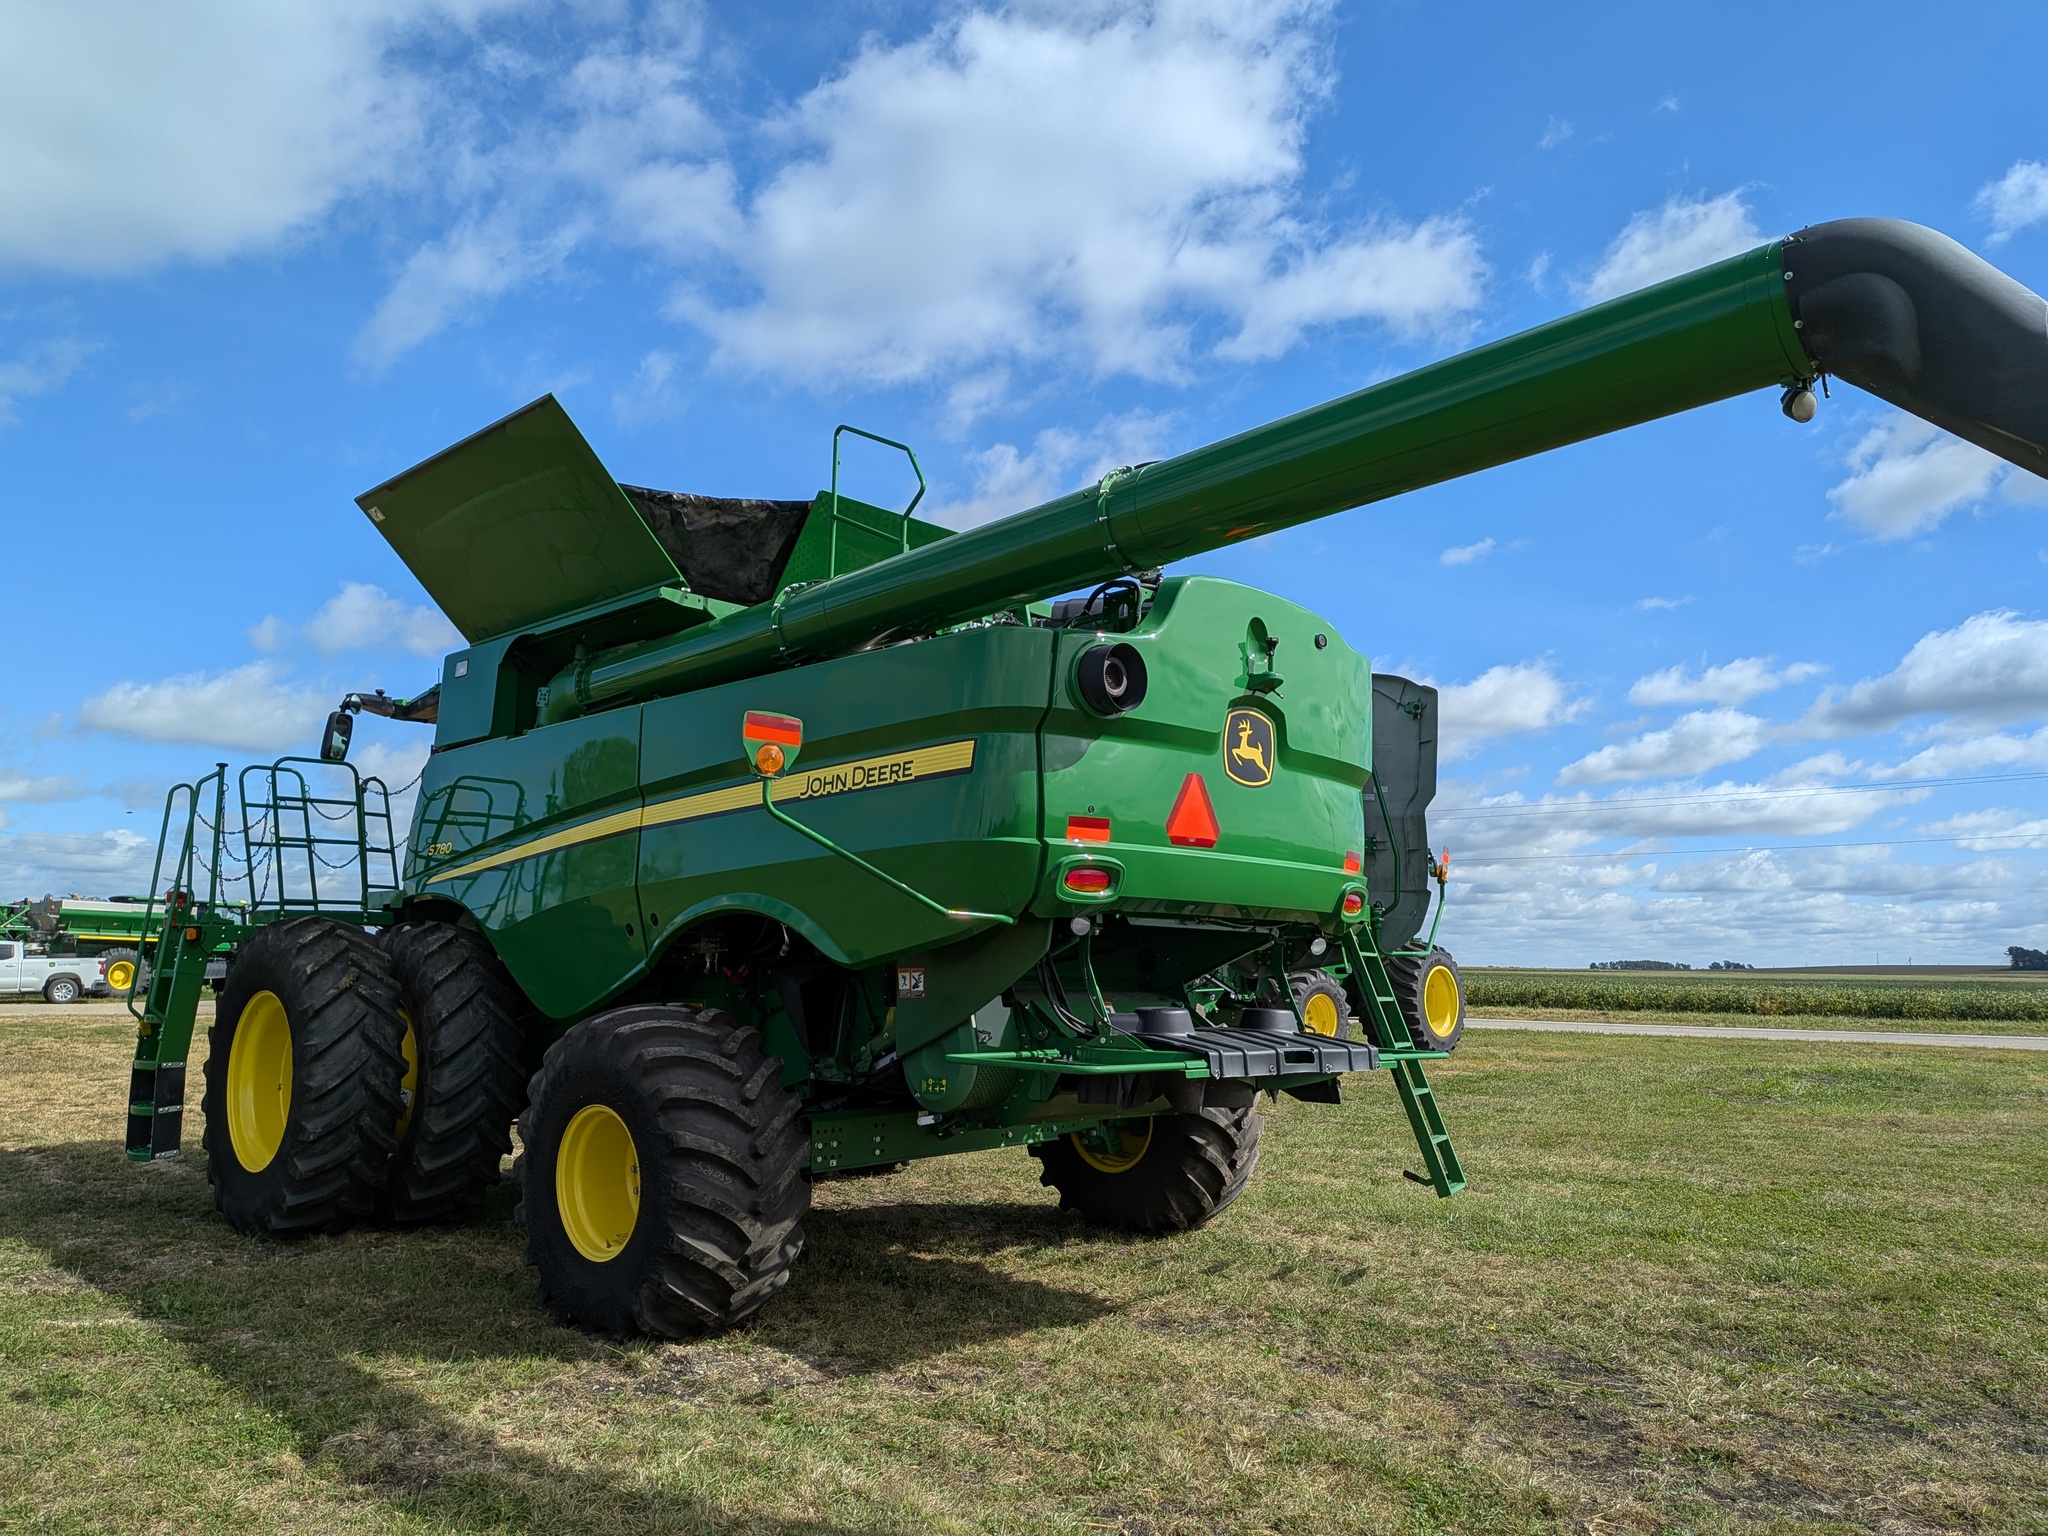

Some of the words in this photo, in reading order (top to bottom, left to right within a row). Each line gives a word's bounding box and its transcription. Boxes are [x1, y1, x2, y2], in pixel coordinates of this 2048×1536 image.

[800, 772, 848, 797] JOHN
[851, 760, 914, 787] DEERE
[428, 841, 453, 856] S780
